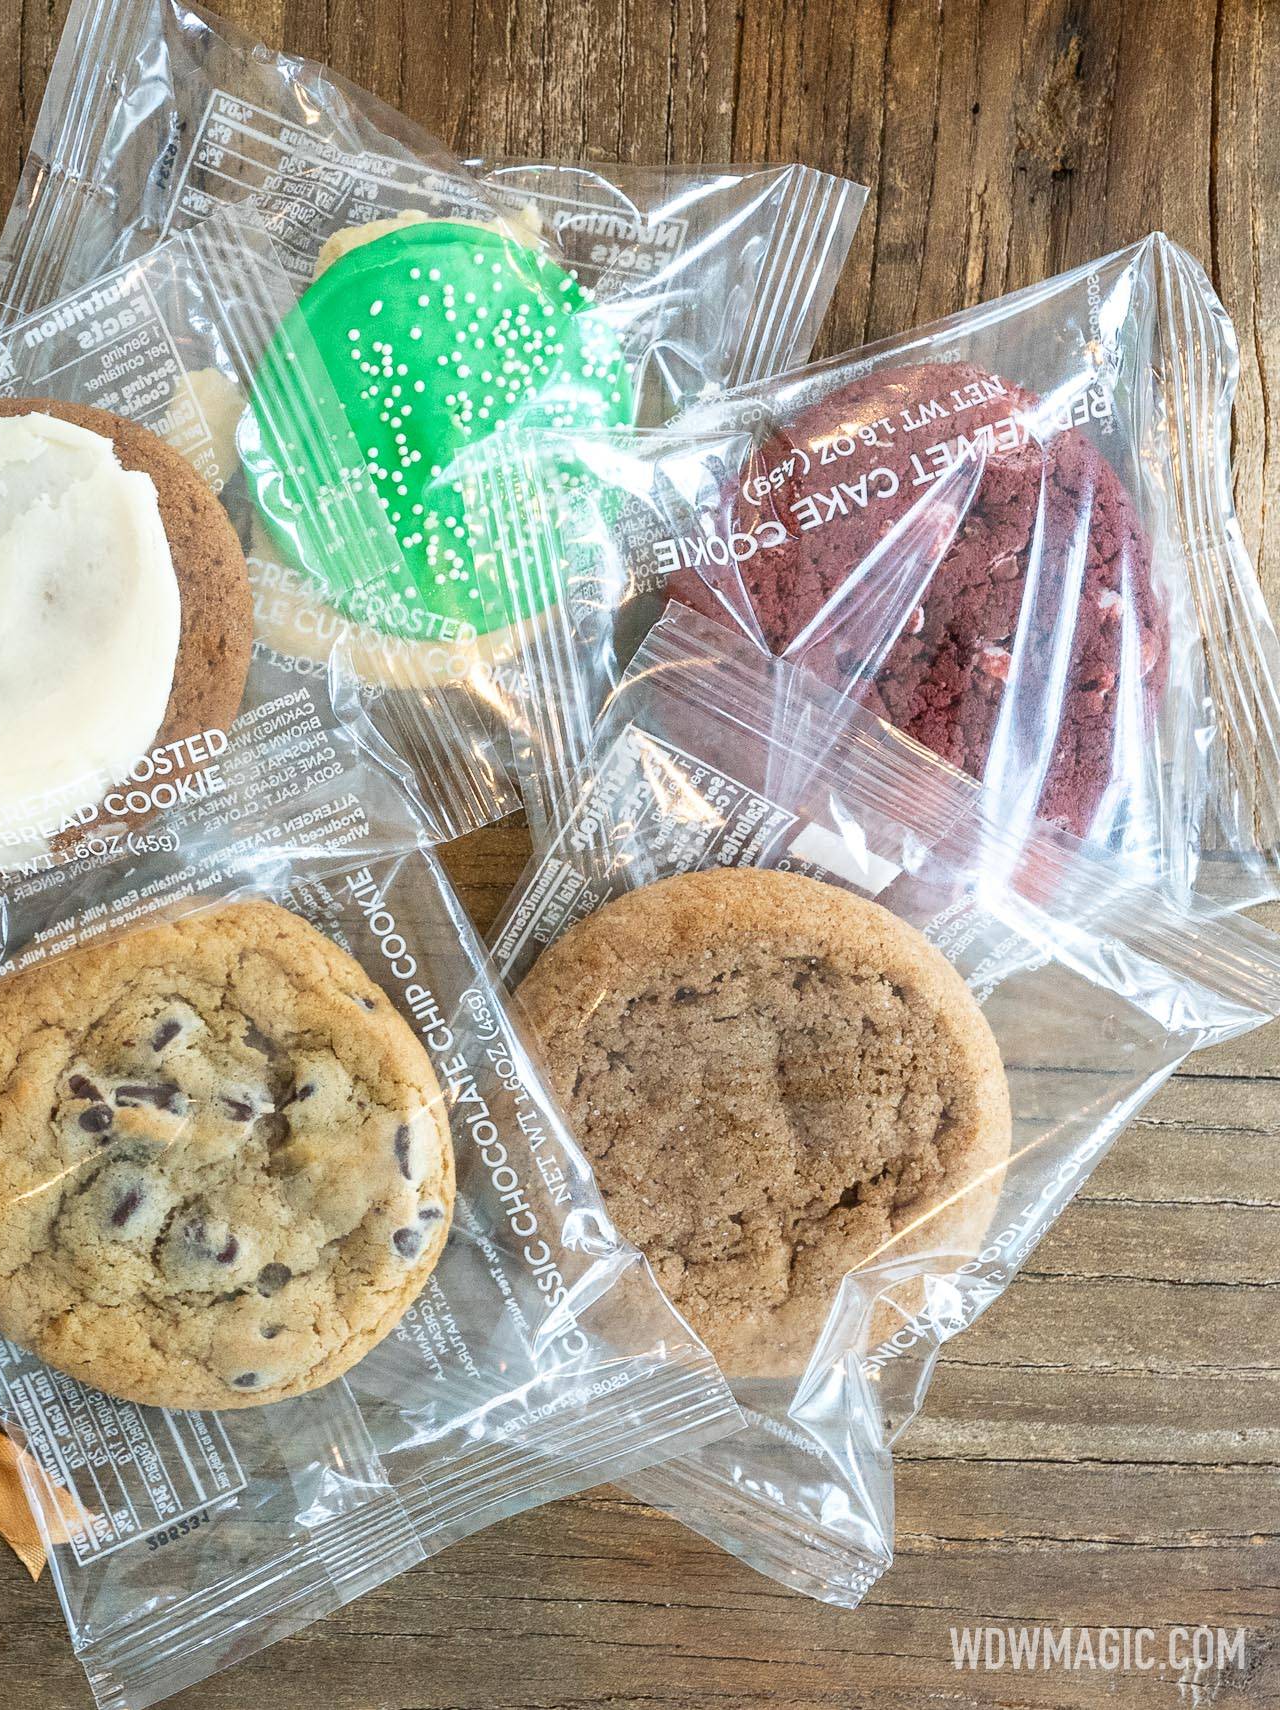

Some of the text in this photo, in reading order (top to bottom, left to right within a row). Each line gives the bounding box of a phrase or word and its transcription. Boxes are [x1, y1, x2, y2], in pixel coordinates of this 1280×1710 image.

[738, 372, 1008, 507] NET WT 1.6 OZ (45g)
[786, 461, 900, 533] CAKE
[649, 517, 789, 574] COOKIE
[349, 589, 479, 649] FROSTED
[94, 724, 232, 796] FROSTED
[101, 763, 228, 817] COOKIE
[17, 850, 58, 878] WT
[60, 837, 125, 865] 1.6OZ
[124, 831, 183, 858] (45g)
[344, 862, 422, 985] COOKIE
[401, 977, 458, 1057] CHIP
[455, 983, 503, 1045] (45g)
[436, 1050, 543, 1241] CHOCOLATE
[514, 1103, 551, 1152] WT
[534, 1149, 575, 1206] NET
